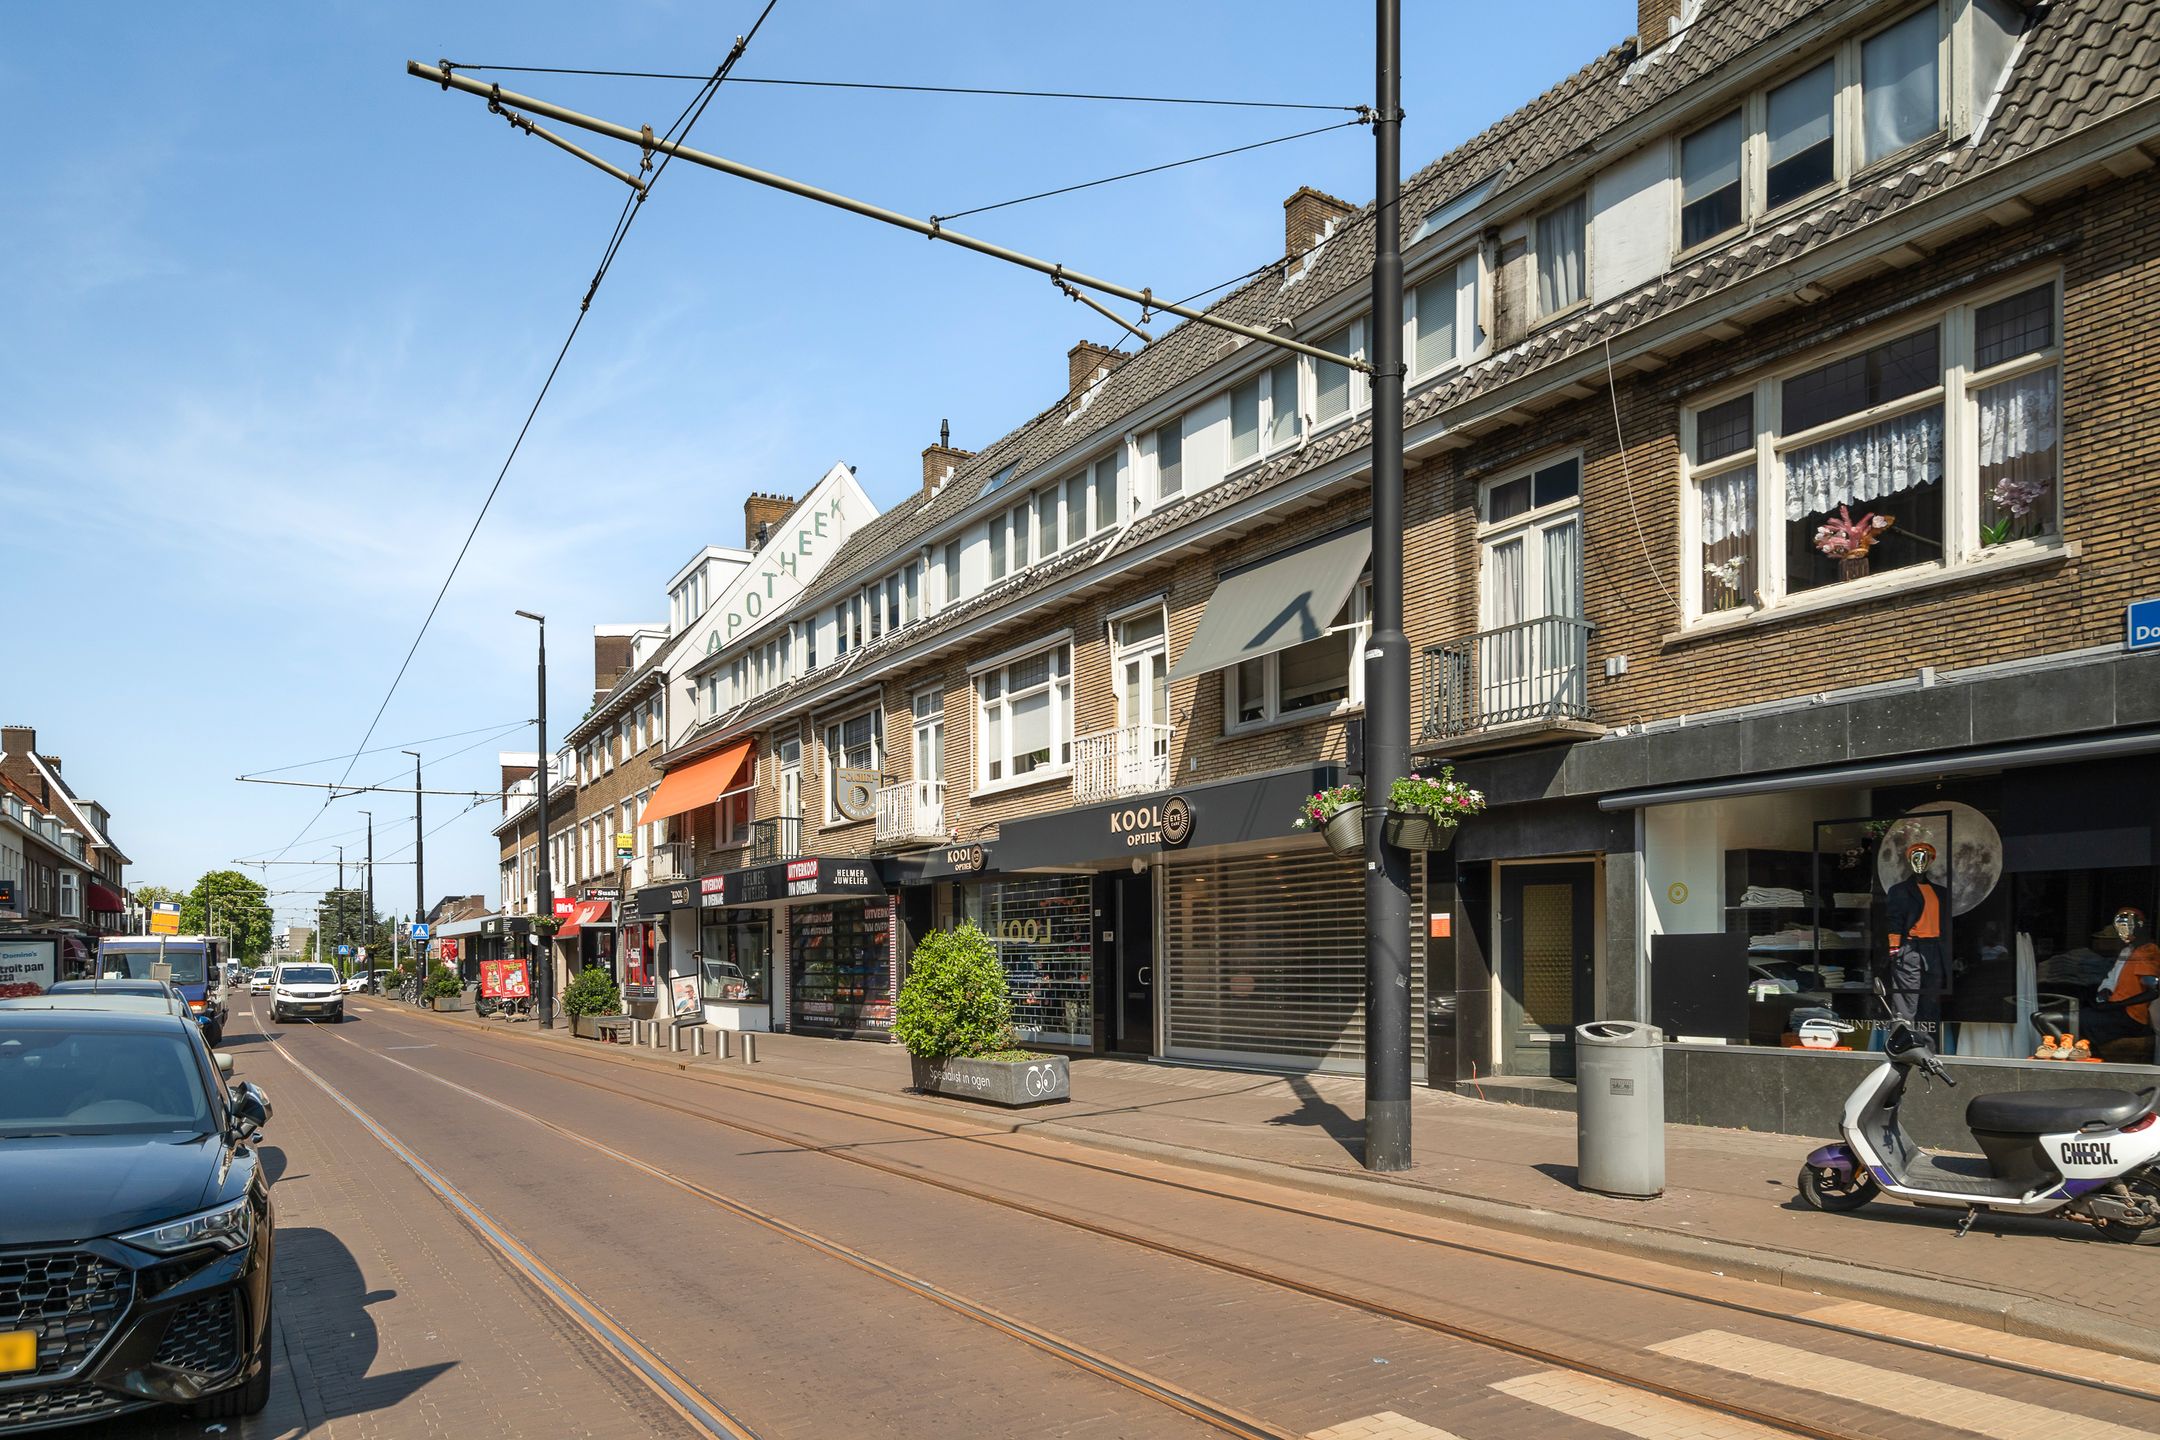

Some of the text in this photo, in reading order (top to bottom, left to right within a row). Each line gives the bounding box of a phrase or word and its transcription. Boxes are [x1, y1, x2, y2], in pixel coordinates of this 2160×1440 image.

[706, 495, 846, 656] APOTHEEK
[1111, 806, 1161, 833] KOOL
[1169, 813, 1181, 822] EYE
[1127, 831, 1161, 847] OPTIEK
[787, 861, 817, 878] UITVERKOOP
[836, 869, 865, 877] HELMER
[833, 877, 869, 885] JUWELIER
[556, 903, 574, 914] Dirk
[2, 951, 38, 959] Domino's
[24, 963, 44, 973] pan
[929, 1065, 991, 1090] Specialist in ogen
